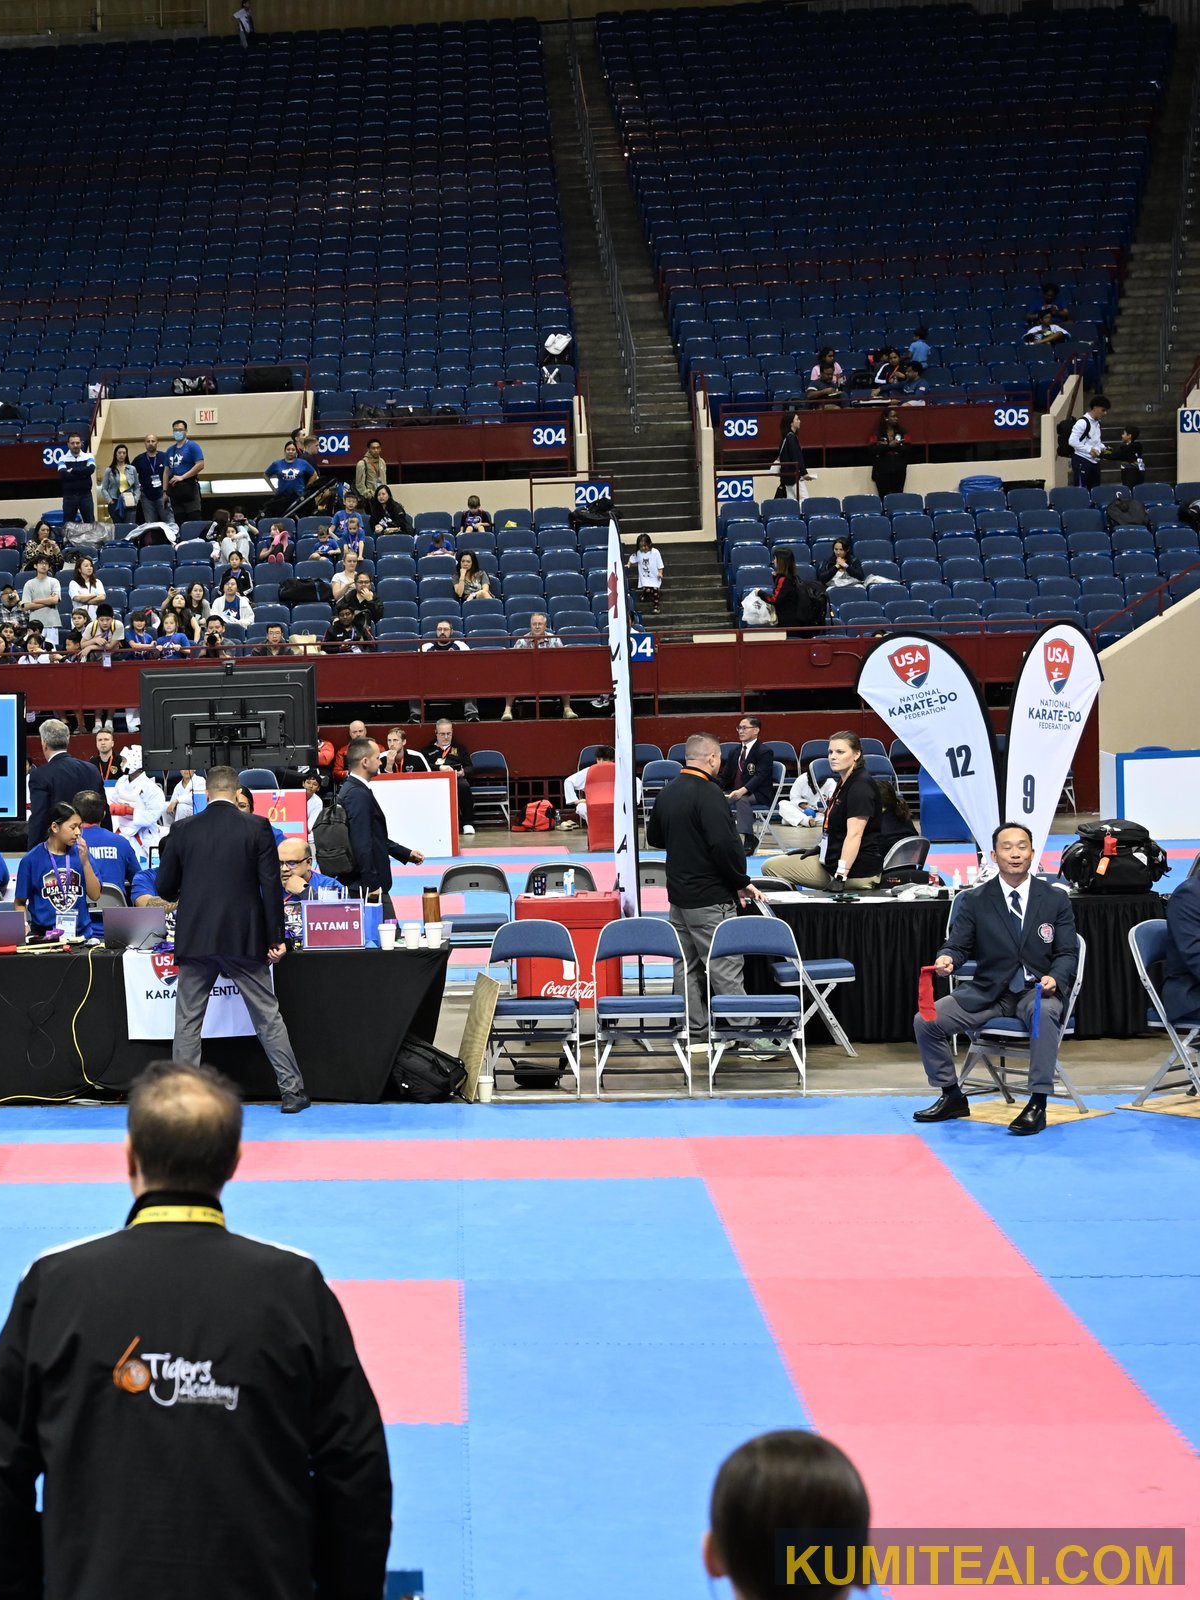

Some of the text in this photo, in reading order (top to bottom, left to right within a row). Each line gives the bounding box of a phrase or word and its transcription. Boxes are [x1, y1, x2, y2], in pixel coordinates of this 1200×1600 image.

[199, 410, 215, 422] EXIT
[993, 408, 1029, 427] 305
[1183, 410, 1200, 432] 30
[532, 428, 567, 445] 304
[723, 419, 759, 437] 305
[318, 436, 351, 453] 304
[43, 448, 65, 465] 30
[575, 486, 612, 504] 204
[717, 480, 754, 499] 205
[630, 636, 654, 658] 04
[1047, 646, 1070, 664] USA
[893, 650, 926, 667] USA
[888, 692, 958, 717] KARATE-DO
[900, 688, 942, 704] NATIONAL
[1039, 699, 1071, 710] NATIONAL
[904, 706, 946, 720] FEDERATION
[1028, 708, 1082, 723] KARATE-DO
[1038, 722, 1071, 731] FEDERATION
[945, 744, 975, 779] 12
[1022, 774, 1036, 815] 9
[268, 807, 287, 822] 01
[89, 846, 118, 860] UNTEER
[46, 885, 59, 894] USA
[287, 914, 302, 923] OPE
[308, 921, 360, 930] TATAMI 9
[155, 956, 174, 966] US
[146, 990, 177, 1000] KARA
[209, 985, 240, 997] ENTU
[541, 981, 596, 999] Coca-Cola
[140, 1352, 213, 1406] Tigers
[179, 1378, 240, 1411] Academy
